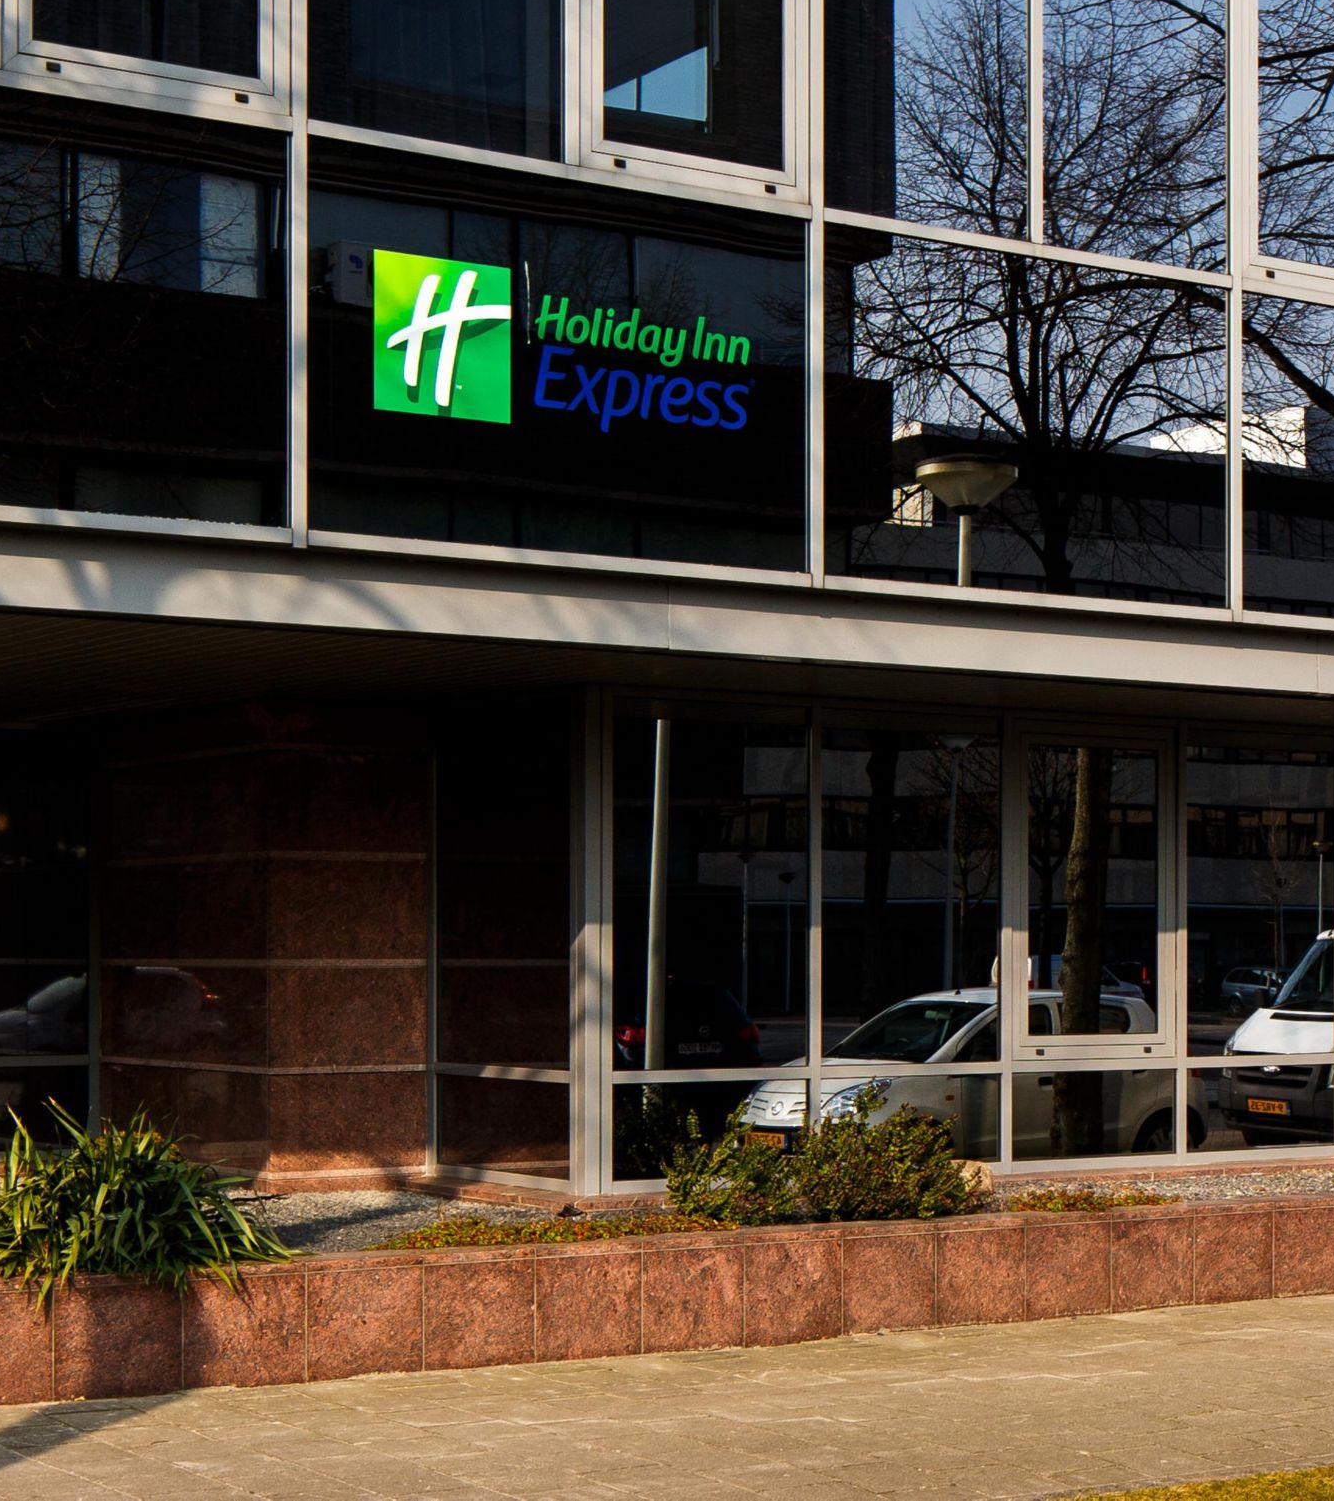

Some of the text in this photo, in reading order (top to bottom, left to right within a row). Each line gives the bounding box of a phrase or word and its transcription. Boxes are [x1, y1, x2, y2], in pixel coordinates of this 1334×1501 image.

[534, 294, 751, 368] Holiday Inn
[533, 344, 750, 433] Express
